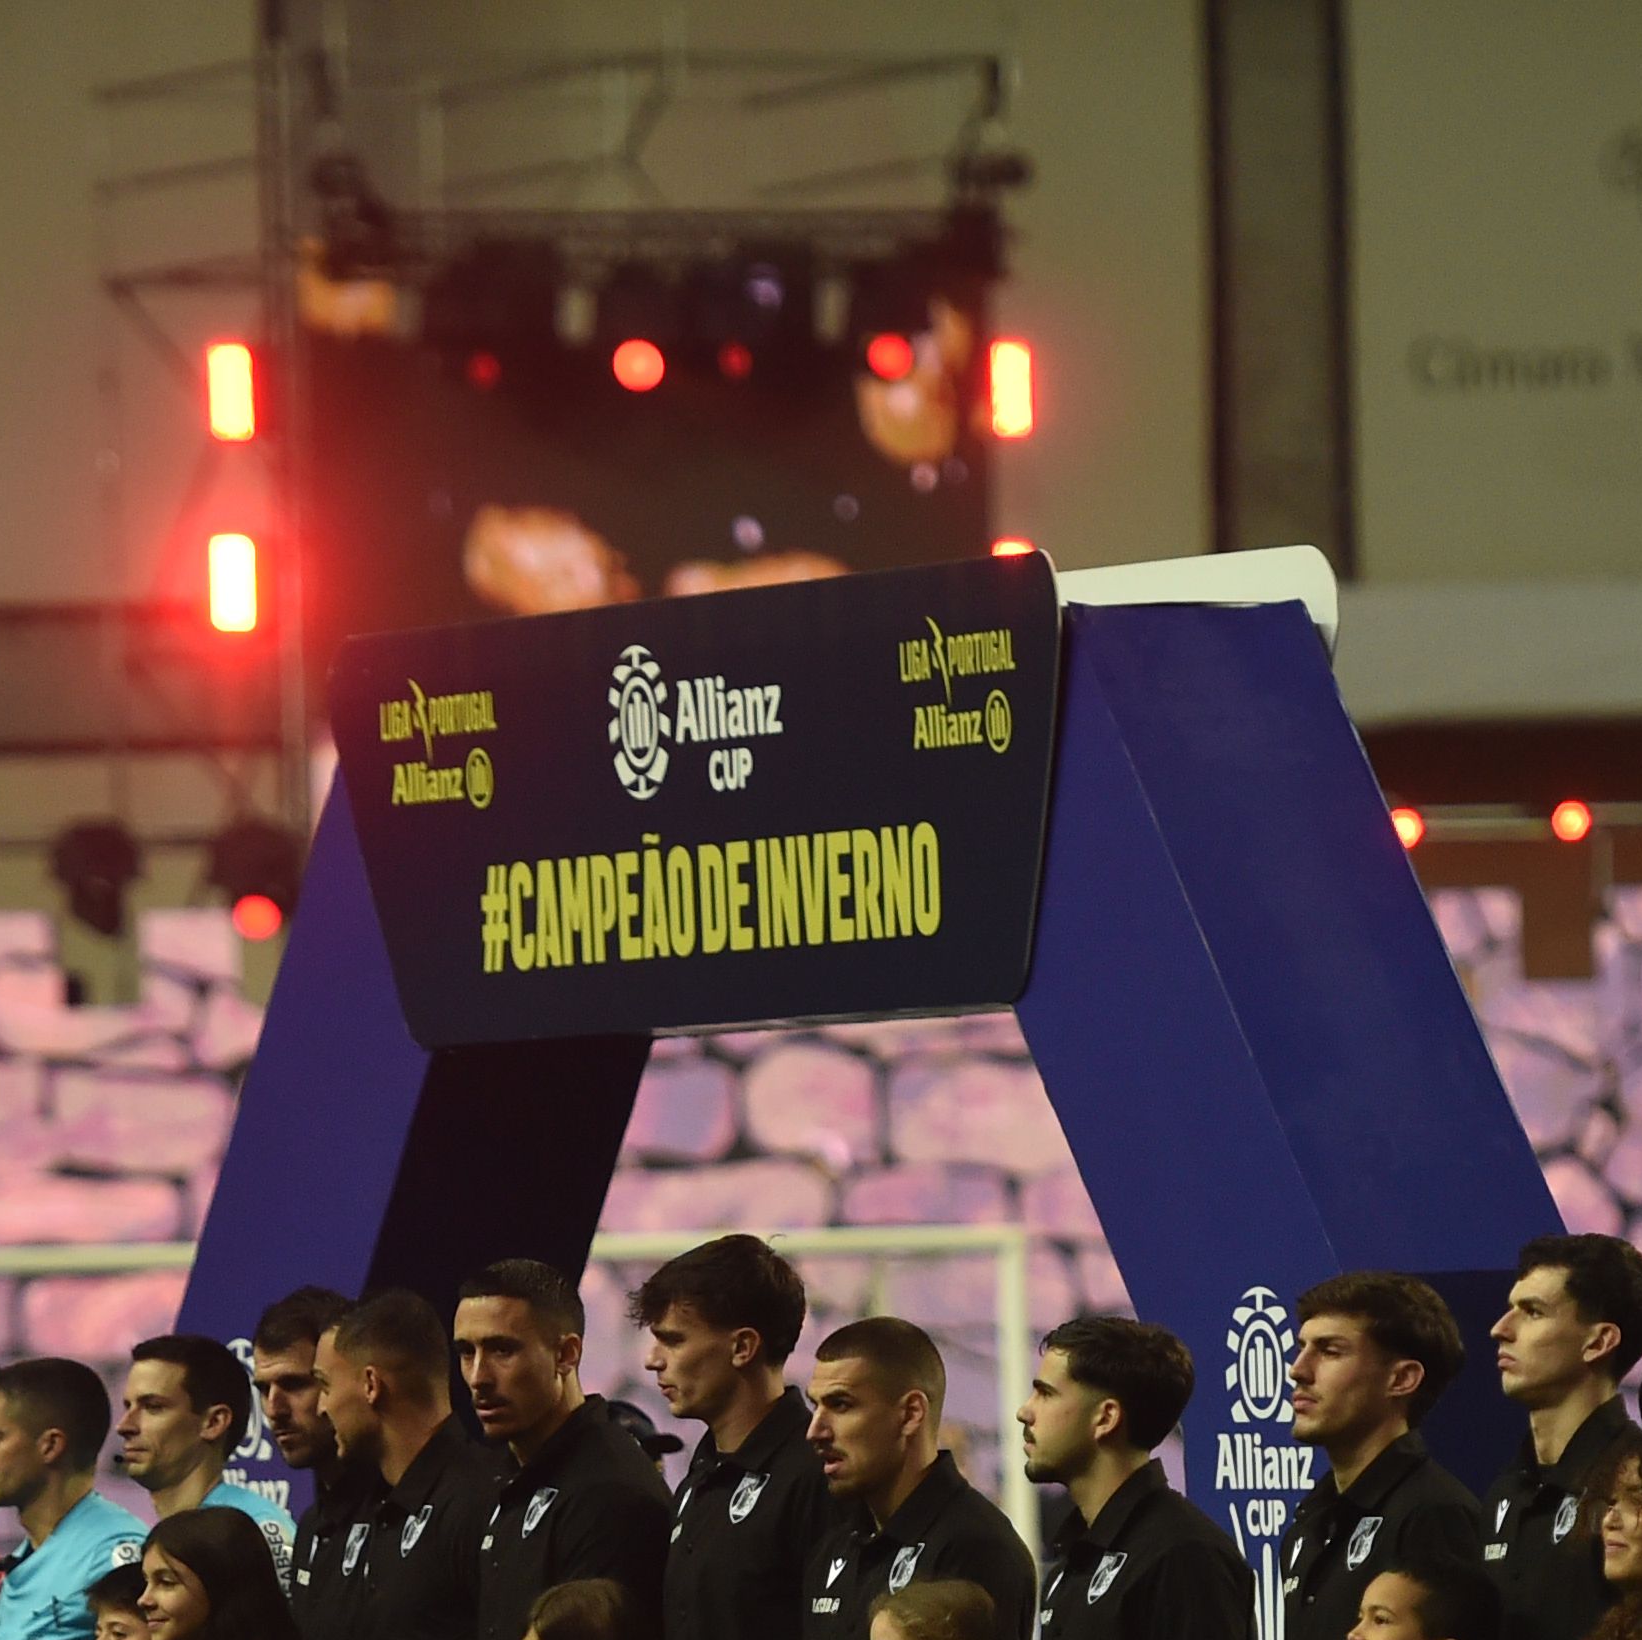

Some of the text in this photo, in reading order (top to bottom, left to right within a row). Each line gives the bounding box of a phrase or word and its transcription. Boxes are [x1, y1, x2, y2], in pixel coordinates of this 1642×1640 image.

[899, 629, 1017, 683] LIGA PORTUGAL
[428, 691, 498, 736] PORTUGAL
[675, 675, 783, 744] Allianz
[913, 703, 984, 750] Allianz
[391, 761, 465, 806] Allianz
[708, 747, 754, 792] CUP
[1215, 1433, 1315, 1490] Allianz
[1246, 1499, 1287, 1537] CUP
